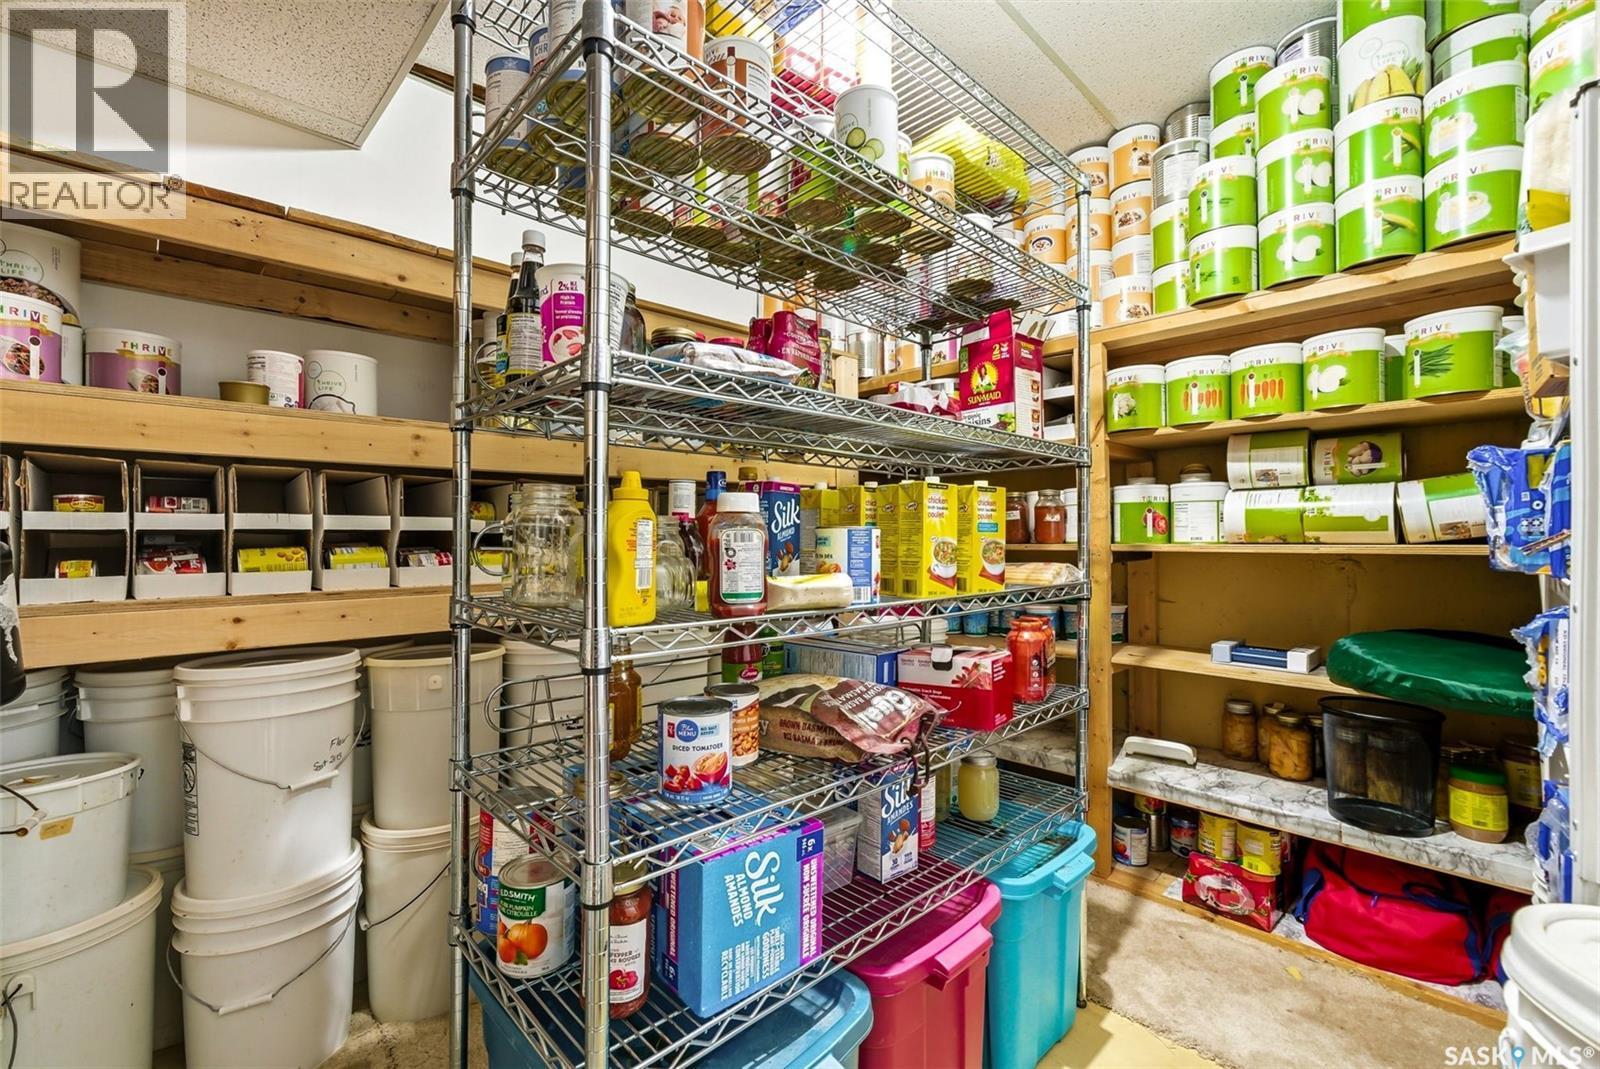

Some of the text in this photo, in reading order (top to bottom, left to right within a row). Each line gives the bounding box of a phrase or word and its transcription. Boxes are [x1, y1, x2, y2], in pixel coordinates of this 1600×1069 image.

[121, 340, 173, 356] THRIVE
[771, 498, 800, 534] Silk
[672, 744, 691, 752] DICED
[723, 874, 744, 927] AMANDES
[735, 873, 754, 920] ALMOND
[744, 851, 784, 927] Silk
[802, 863, 811, 959] NON SUCRÉE ORIGINALE
[809, 858, 818, 957] UNSWEETENED ORIGINAL
[721, 949, 729, 1002] RECYCLABLE
[762, 931, 770, 979] GOODNESS
